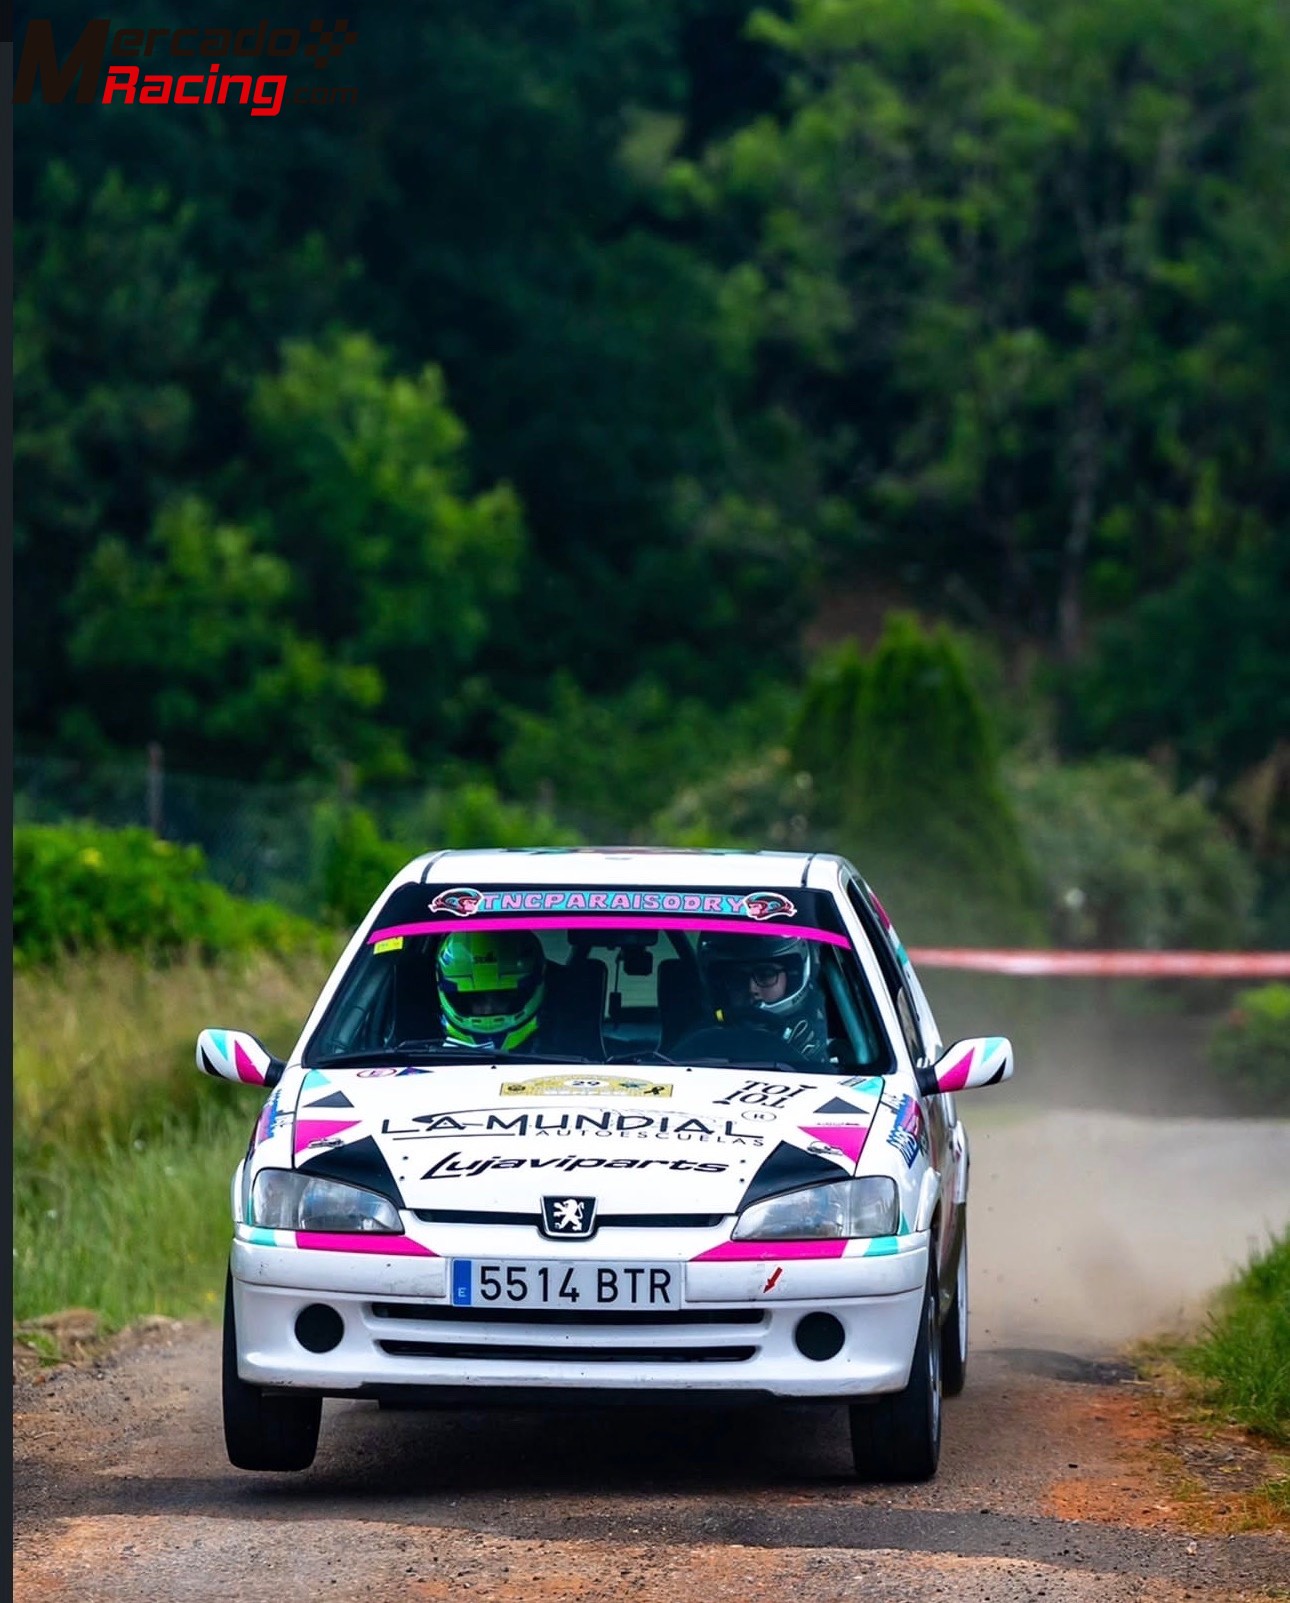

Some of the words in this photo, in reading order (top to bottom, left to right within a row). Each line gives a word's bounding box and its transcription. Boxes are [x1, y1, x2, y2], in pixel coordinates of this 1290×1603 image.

[486, 1111, 764, 1139] MUNDIAL
[535, 1130, 765, 1147] AUTOESCUELAS
[420, 1151, 730, 1180] Lujaviparts
[480, 1266, 580, 1302] 5514
[596, 1268, 672, 1304] BTR
